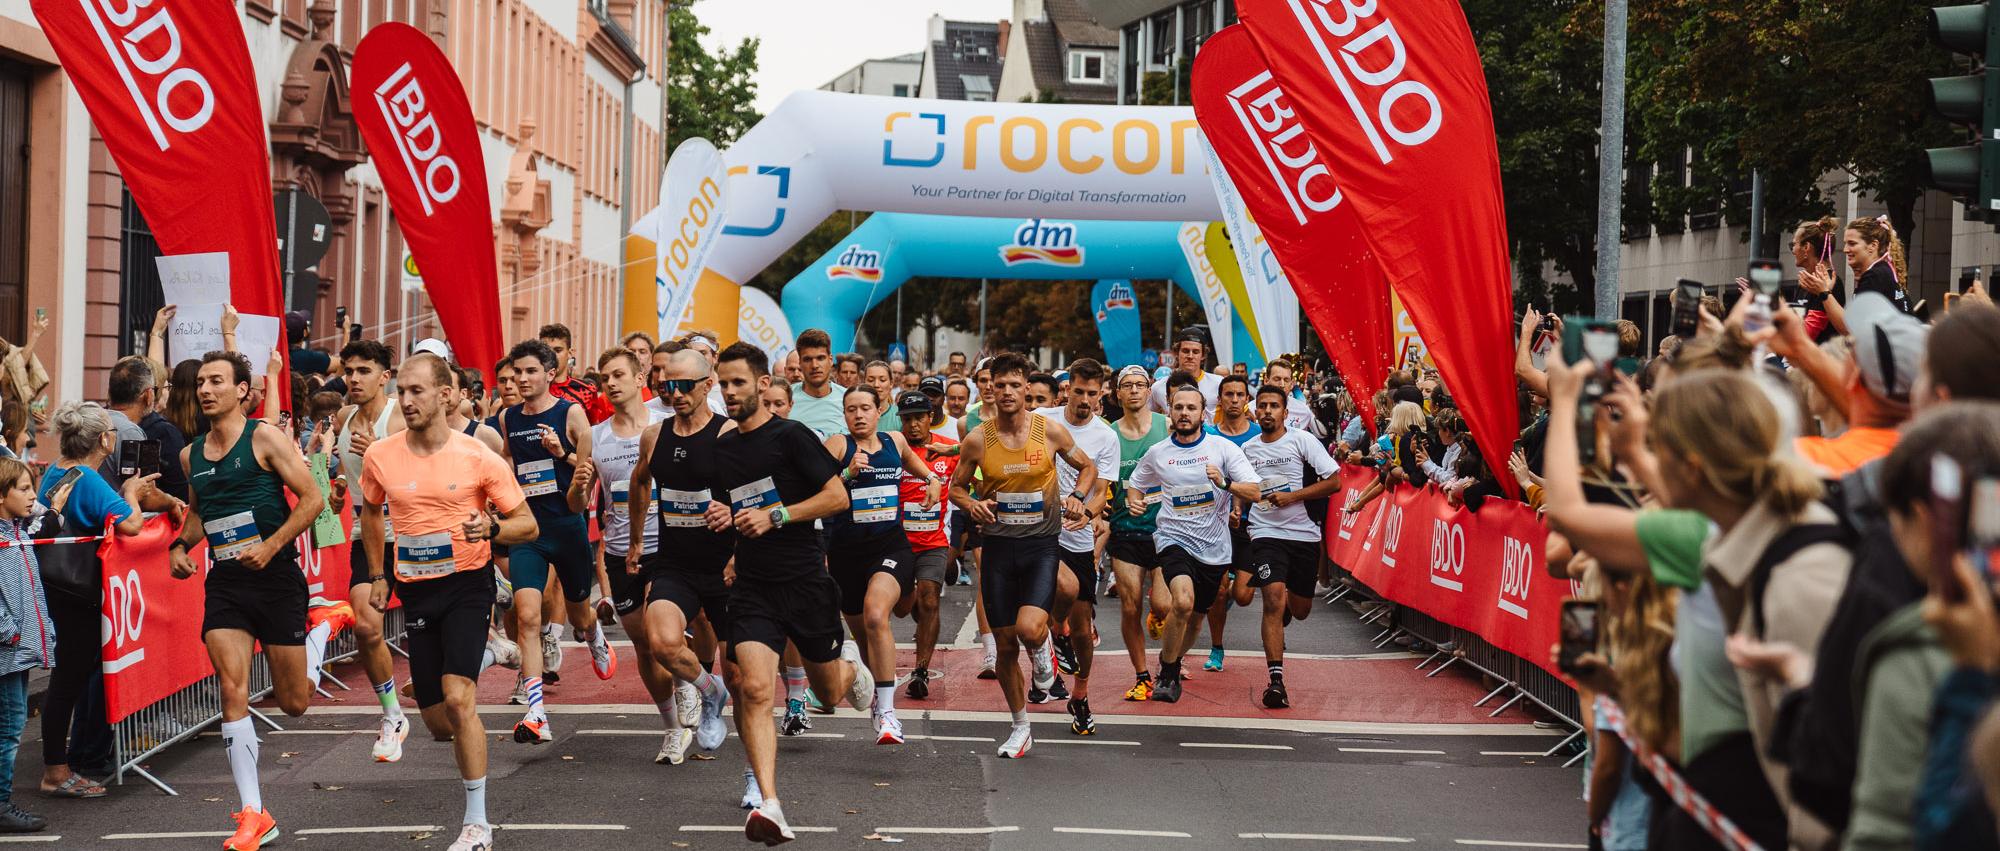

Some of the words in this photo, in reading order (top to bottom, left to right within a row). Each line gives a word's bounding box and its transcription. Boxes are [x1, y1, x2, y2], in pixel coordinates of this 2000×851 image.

[388, 76, 461, 203] BDO
[911, 184, 944, 198] Your
[947, 185, 1002, 200] Partner
[1004, 186, 1025, 201] for
[1028, 188, 1076, 204] Digital
[1078, 189, 1187, 203] Transformation
[664, 176, 721, 287] rocon
[1018, 218, 1072, 247] dm
[839, 247, 877, 268] dm
[1110, 285, 1129, 300] dm
[673, 447, 687, 458] Fe
[1265, 457, 1291, 465] DEUBLIN
[673, 501, 699, 510] Patrick
[867, 497, 886, 505] Maria
[1180, 494, 1206, 503] Christian
[222, 528, 238, 539] Erik
[408, 547, 439, 556] Maurice
[1433, 518, 1465, 576] BDO
[1504, 537, 1532, 601] BDO
